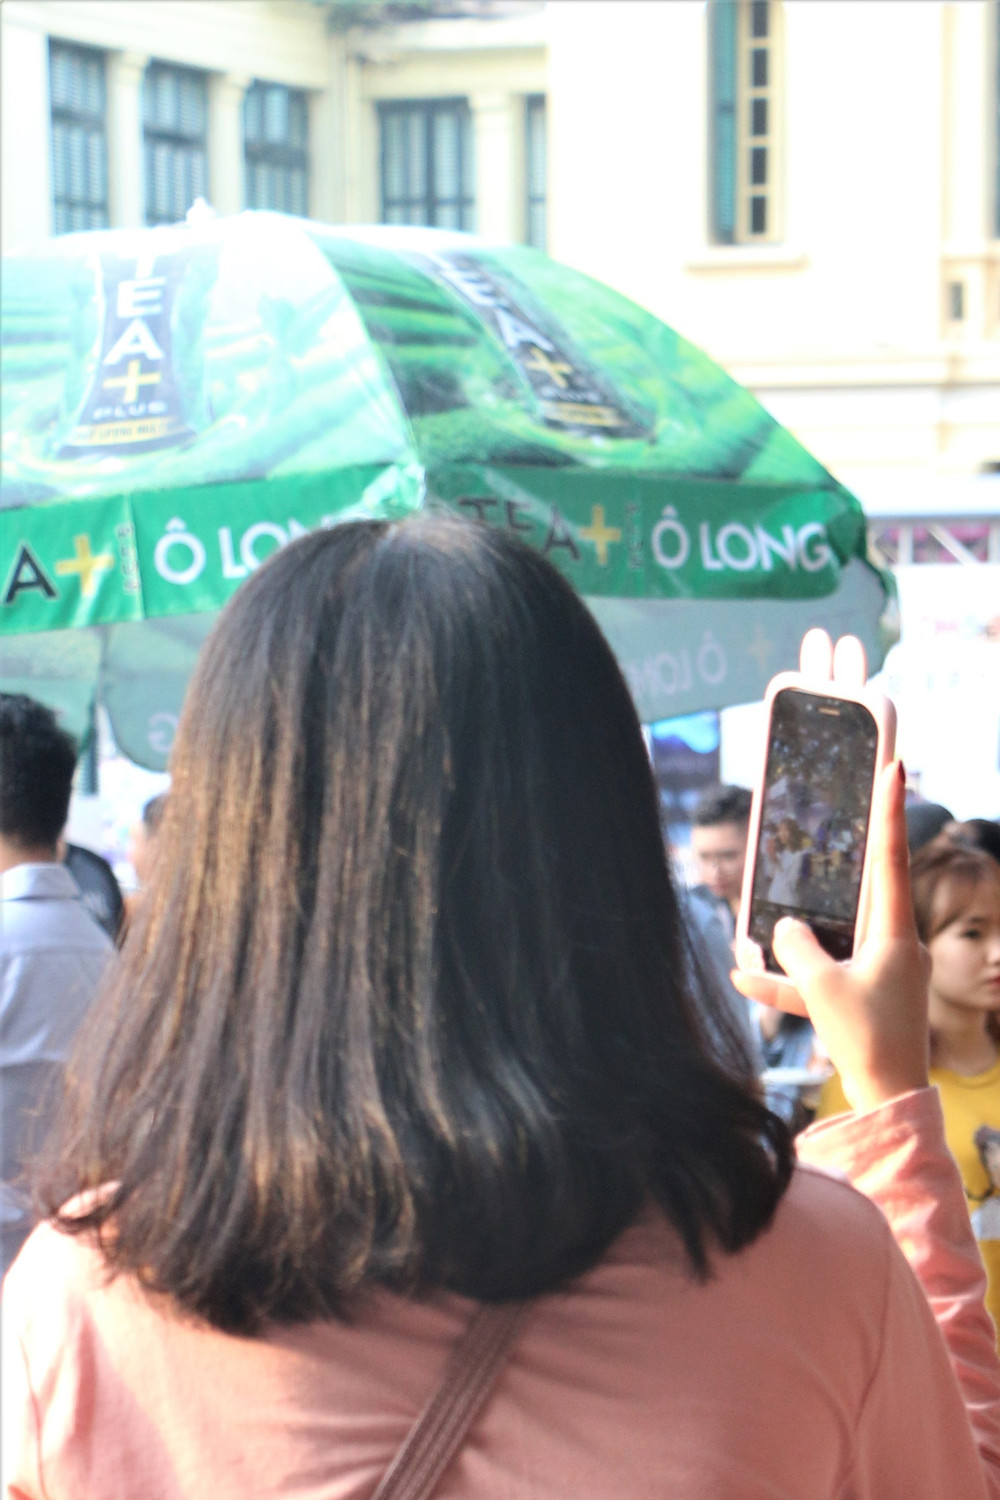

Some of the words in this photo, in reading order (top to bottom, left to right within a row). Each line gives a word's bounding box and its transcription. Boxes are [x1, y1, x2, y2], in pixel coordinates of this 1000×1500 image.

[154, 517, 207, 585] Ô
[651, 504, 690, 569] Ô
[701, 522, 831, 572] LONG
